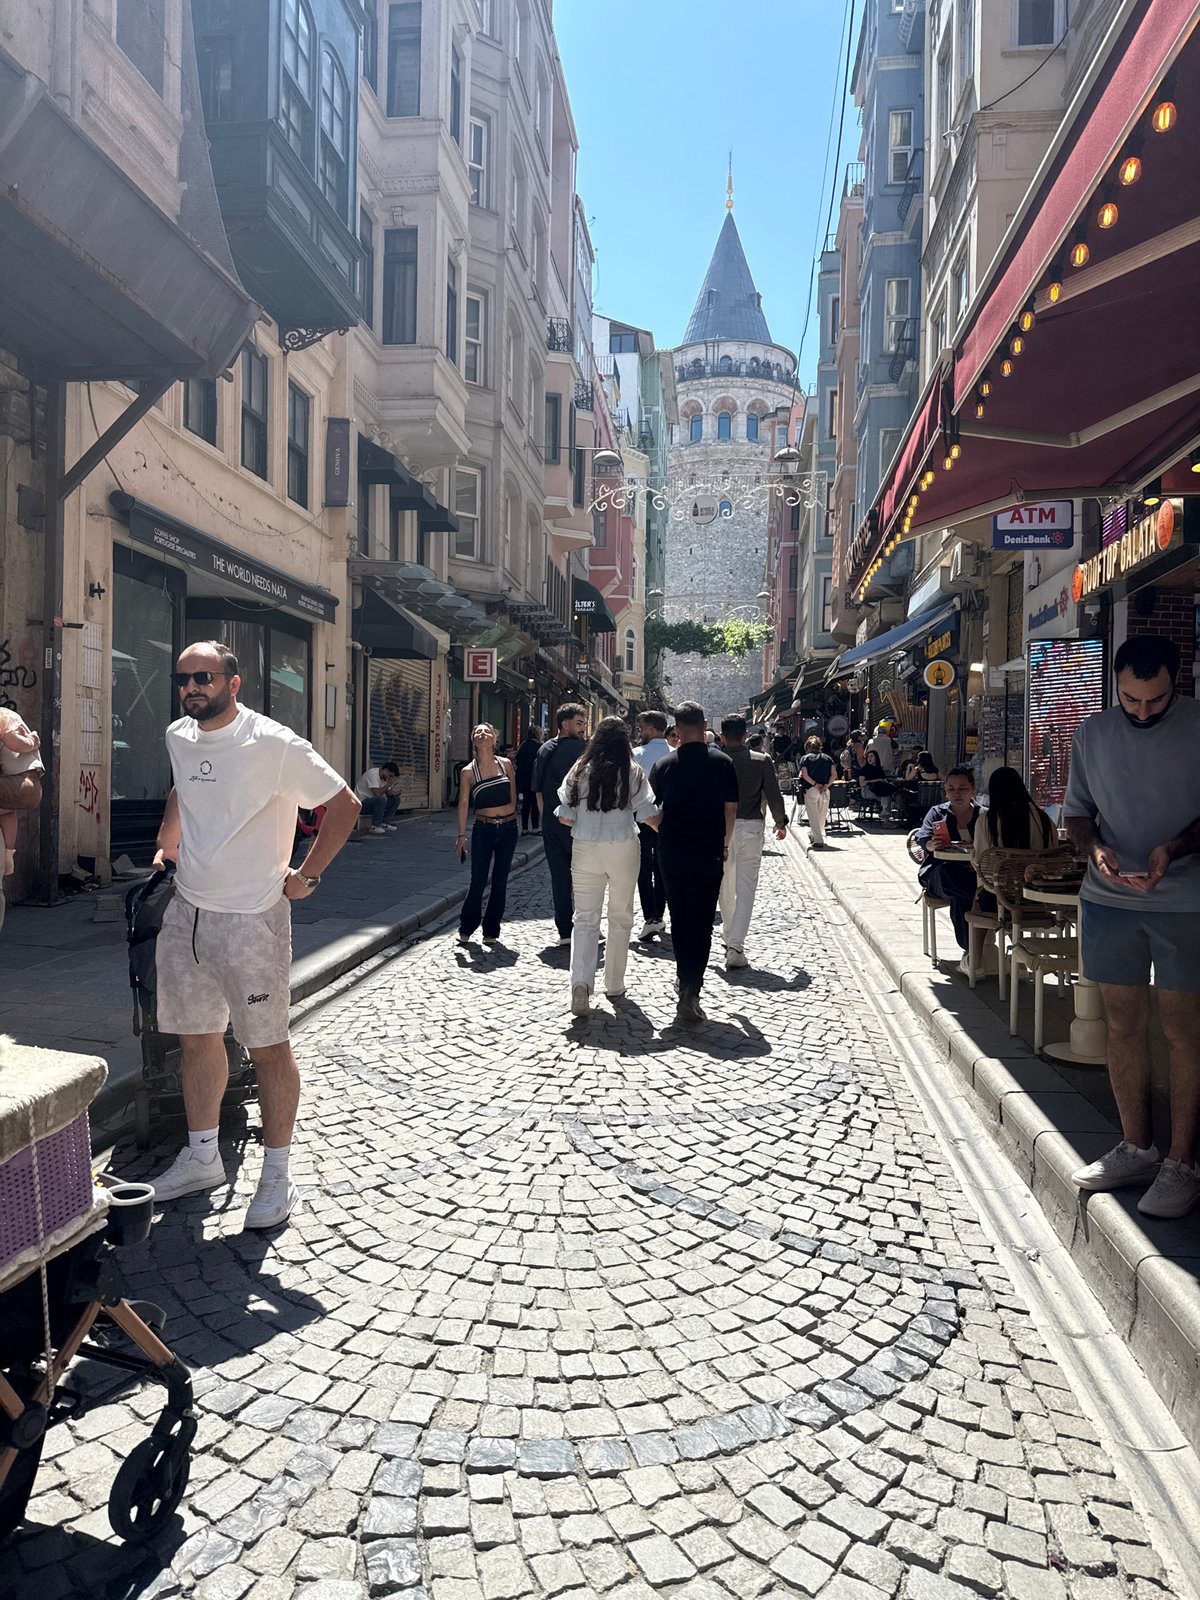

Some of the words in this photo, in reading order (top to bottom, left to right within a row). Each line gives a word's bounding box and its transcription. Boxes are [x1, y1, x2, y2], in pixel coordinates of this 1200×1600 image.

[1009, 507, 1056, 524] ATM
[168, 534, 180, 544] SHOP
[1004, 534, 1051, 544] DenizBank
[1120, 513, 1156, 573] GALATA
[212, 553, 226, 573] THE
[225, 560, 251, 584] WORLD
[251, 572, 271, 593] NEEDS
[271, 582, 288, 600] NATA
[472, 655, 488, 674] E
